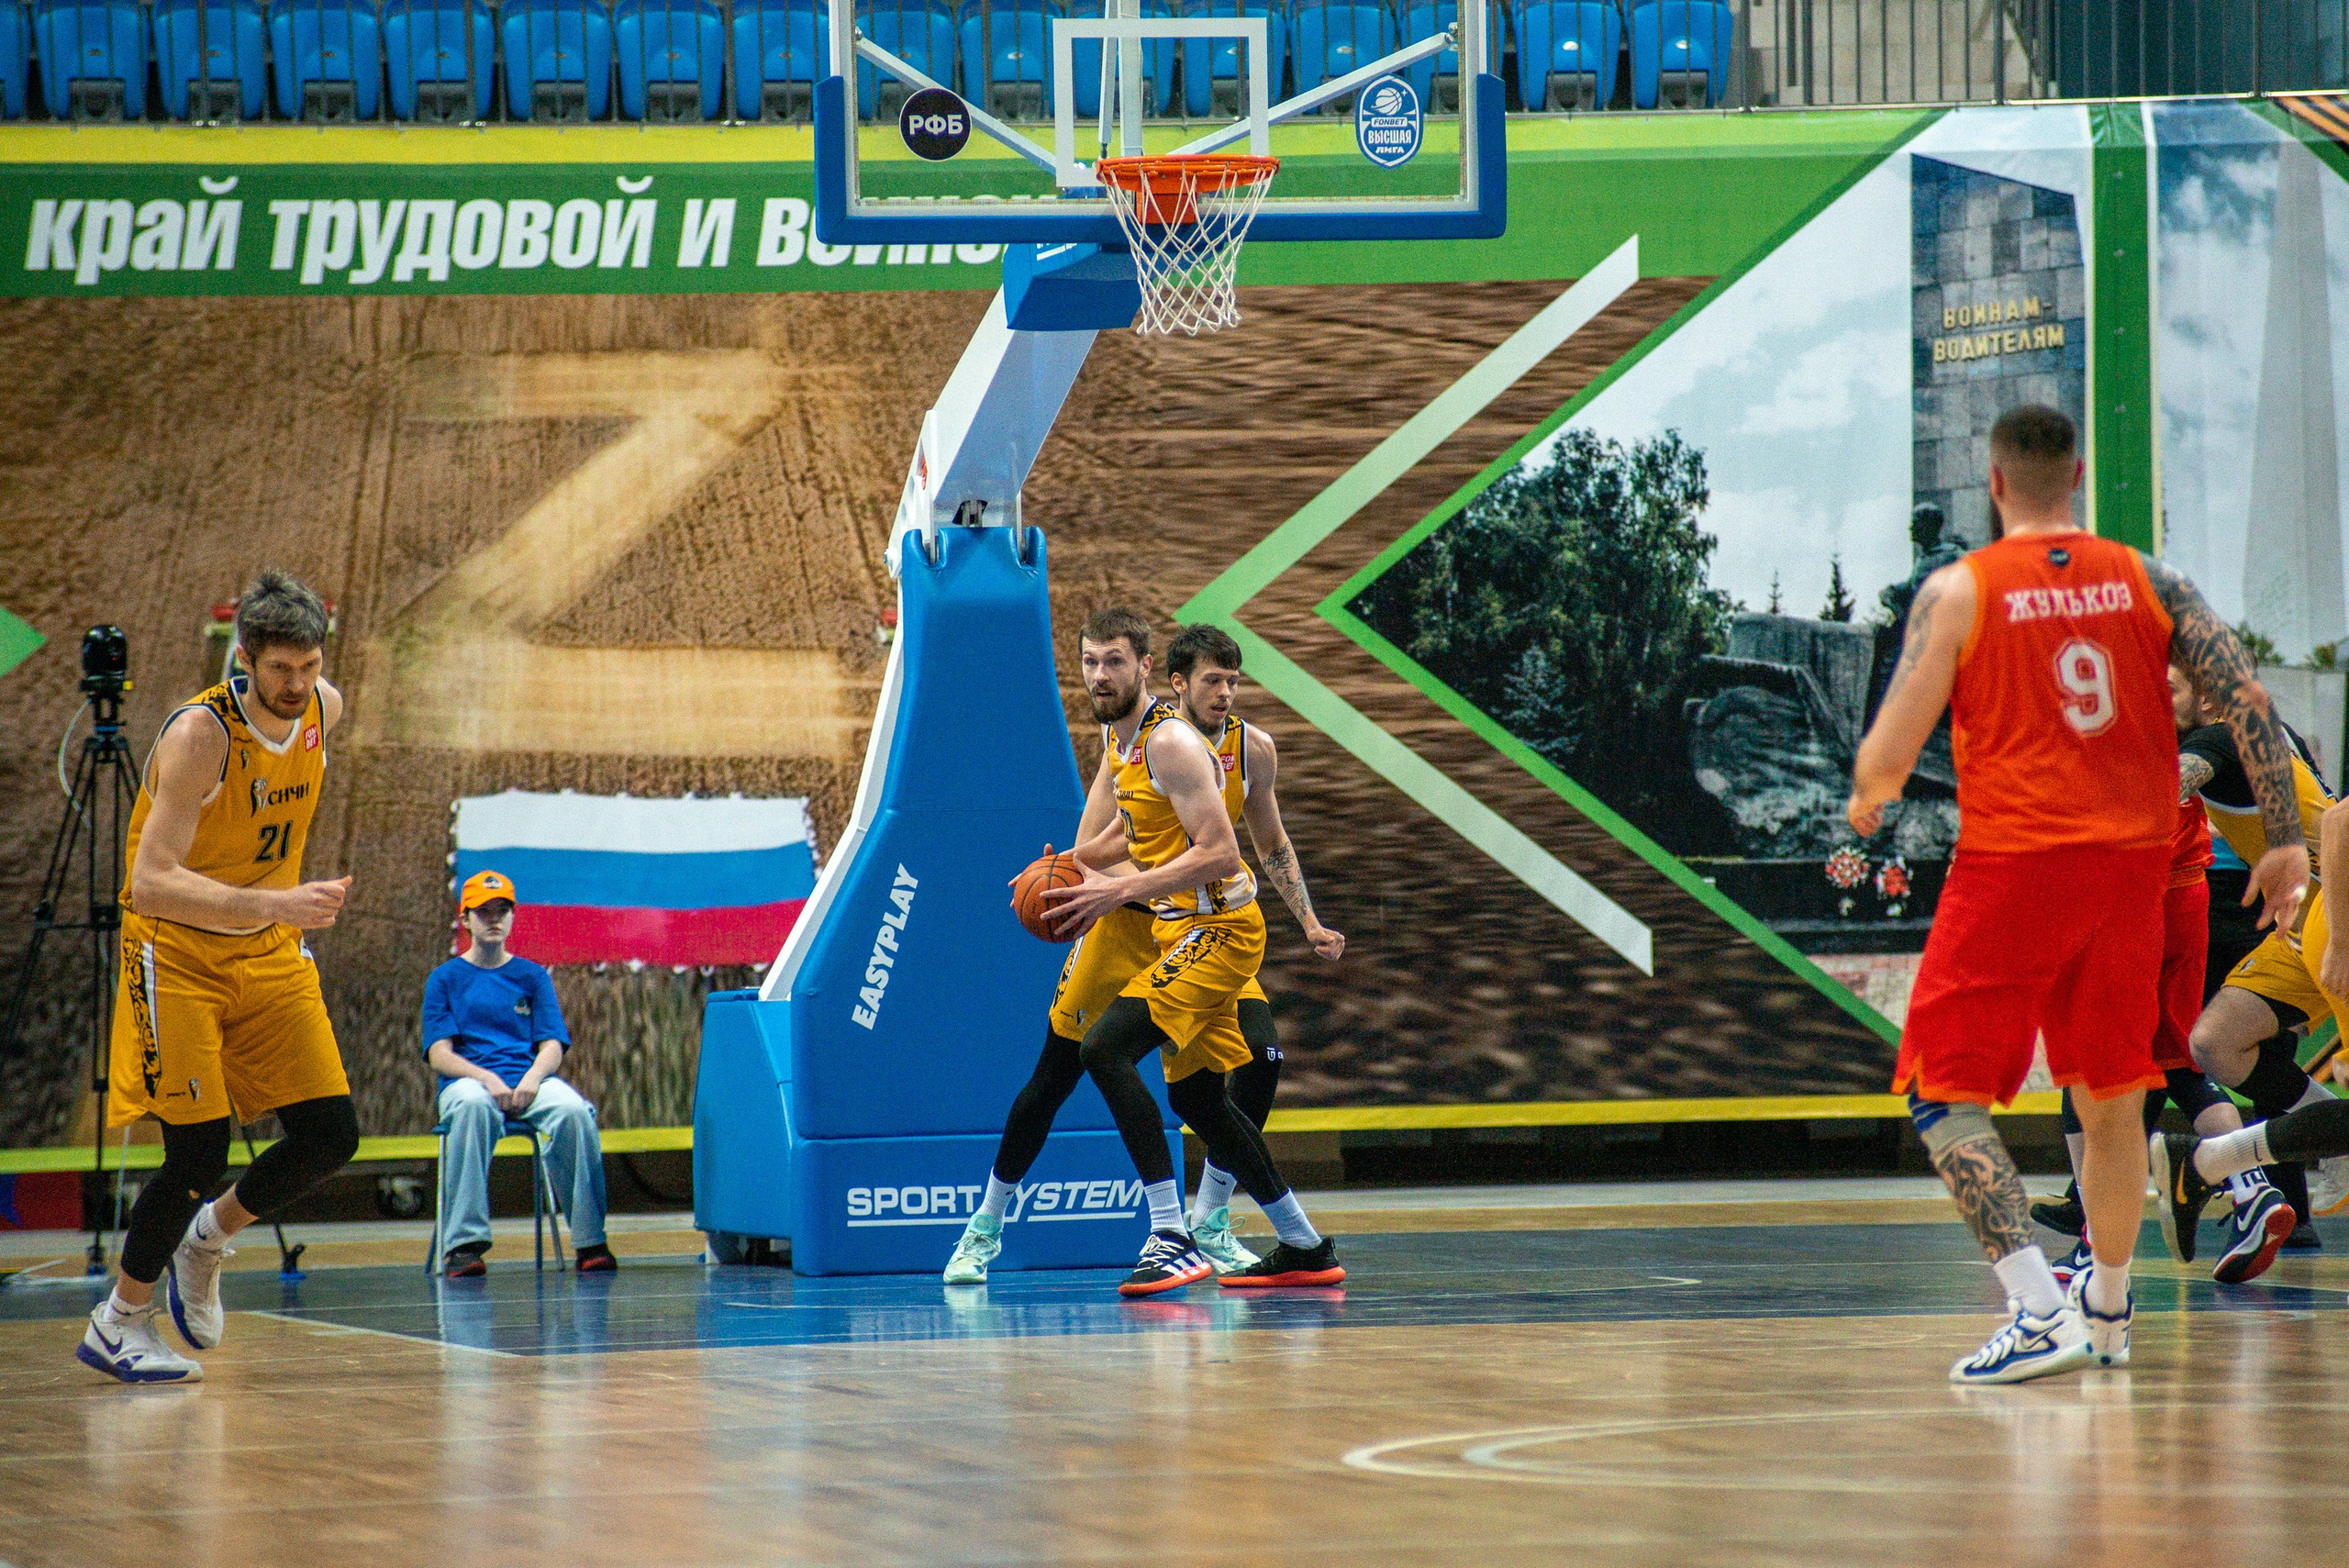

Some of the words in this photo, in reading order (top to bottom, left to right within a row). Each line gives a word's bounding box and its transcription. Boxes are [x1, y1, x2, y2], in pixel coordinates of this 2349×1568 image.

[908, 114, 963, 135] РФБ
[1368, 129, 1412, 144] ВЫСШАЯ
[1375, 146, 1405, 154] ЛИГА
[25, 176, 243, 285] край
[269, 175, 657, 285] трудовой
[1943, 295, 2053, 329] ВОИНАМ-
[1932, 324, 2065, 363] ВОДИТЕЛЯМ
[2054, 638, 2118, 738] 9
[254, 819, 294, 864] 21
[851, 862, 919, 1031] EASYPLAY
[847, 1184, 982, 1216] SPORT
[1004, 1179, 1144, 1223] YSTEM
